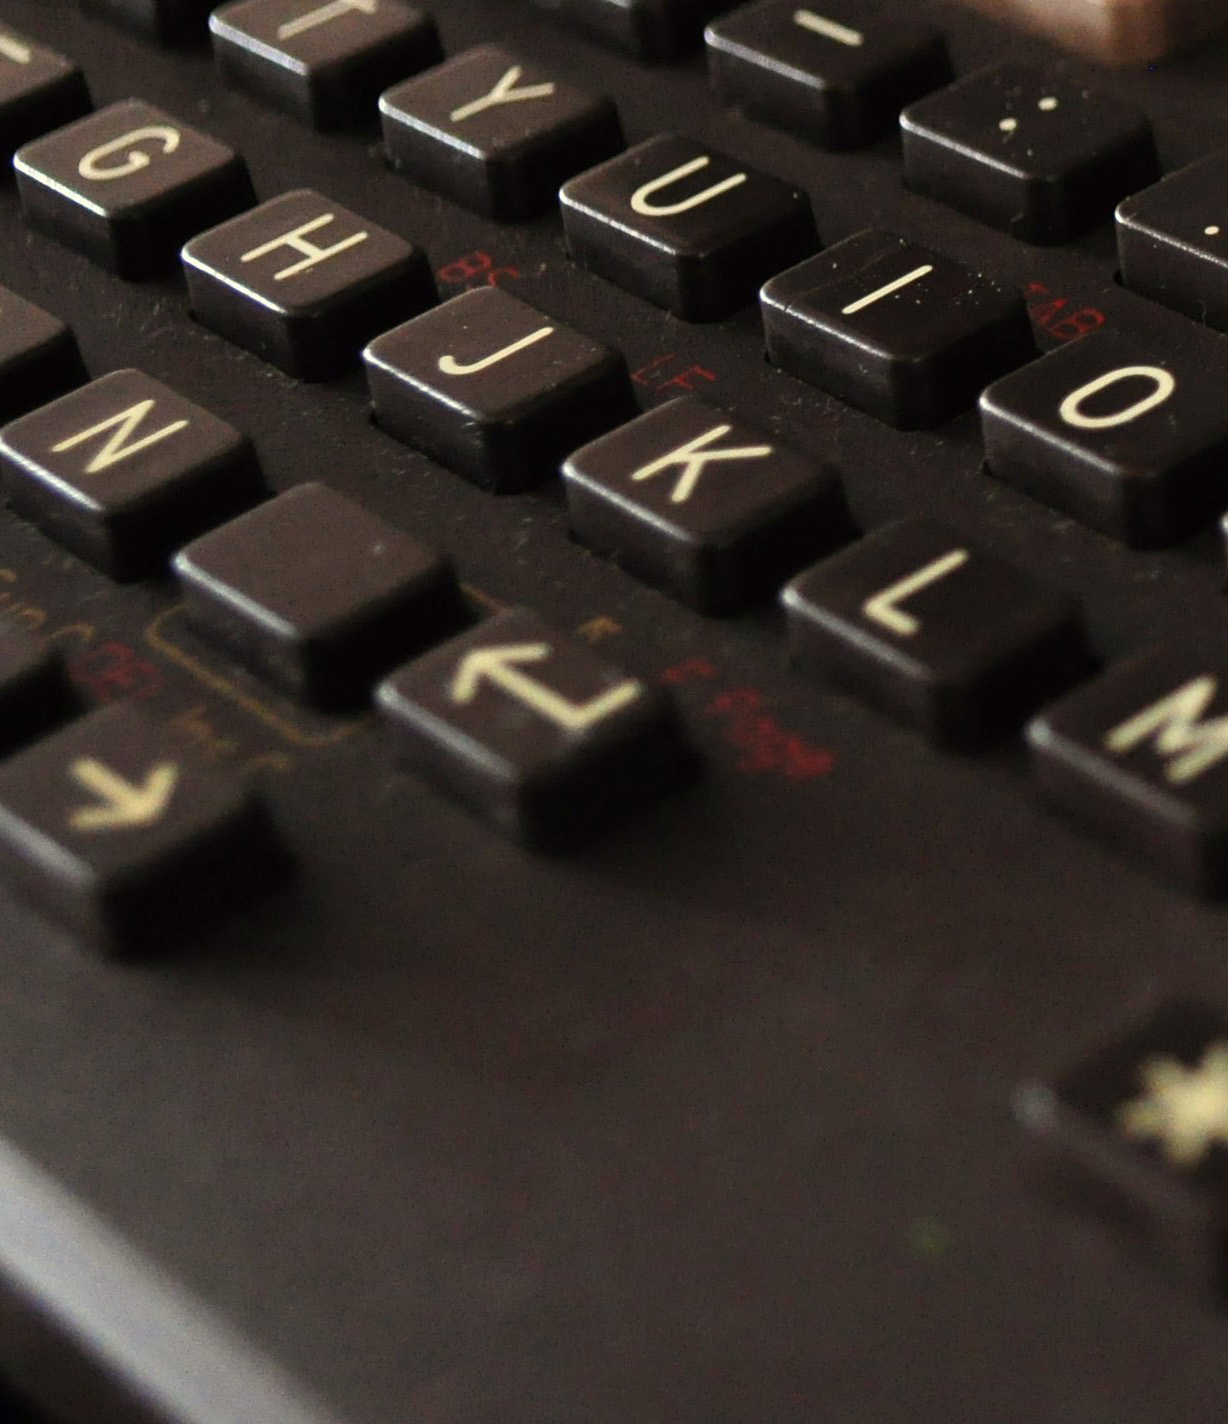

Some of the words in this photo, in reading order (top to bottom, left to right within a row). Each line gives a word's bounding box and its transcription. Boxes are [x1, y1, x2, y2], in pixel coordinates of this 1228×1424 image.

[449, 65, 555, 123] Y
[77, 125, 181, 181] G
[629, 155, 747, 218] U
[239, 212, 369, 282] H
[841, 264, 934, 316] I
[436, 326, 555, 376] J
[51, 398, 190, 475] N
[631, 423, 773, 505] K
[864, 549, 968, 636] L
